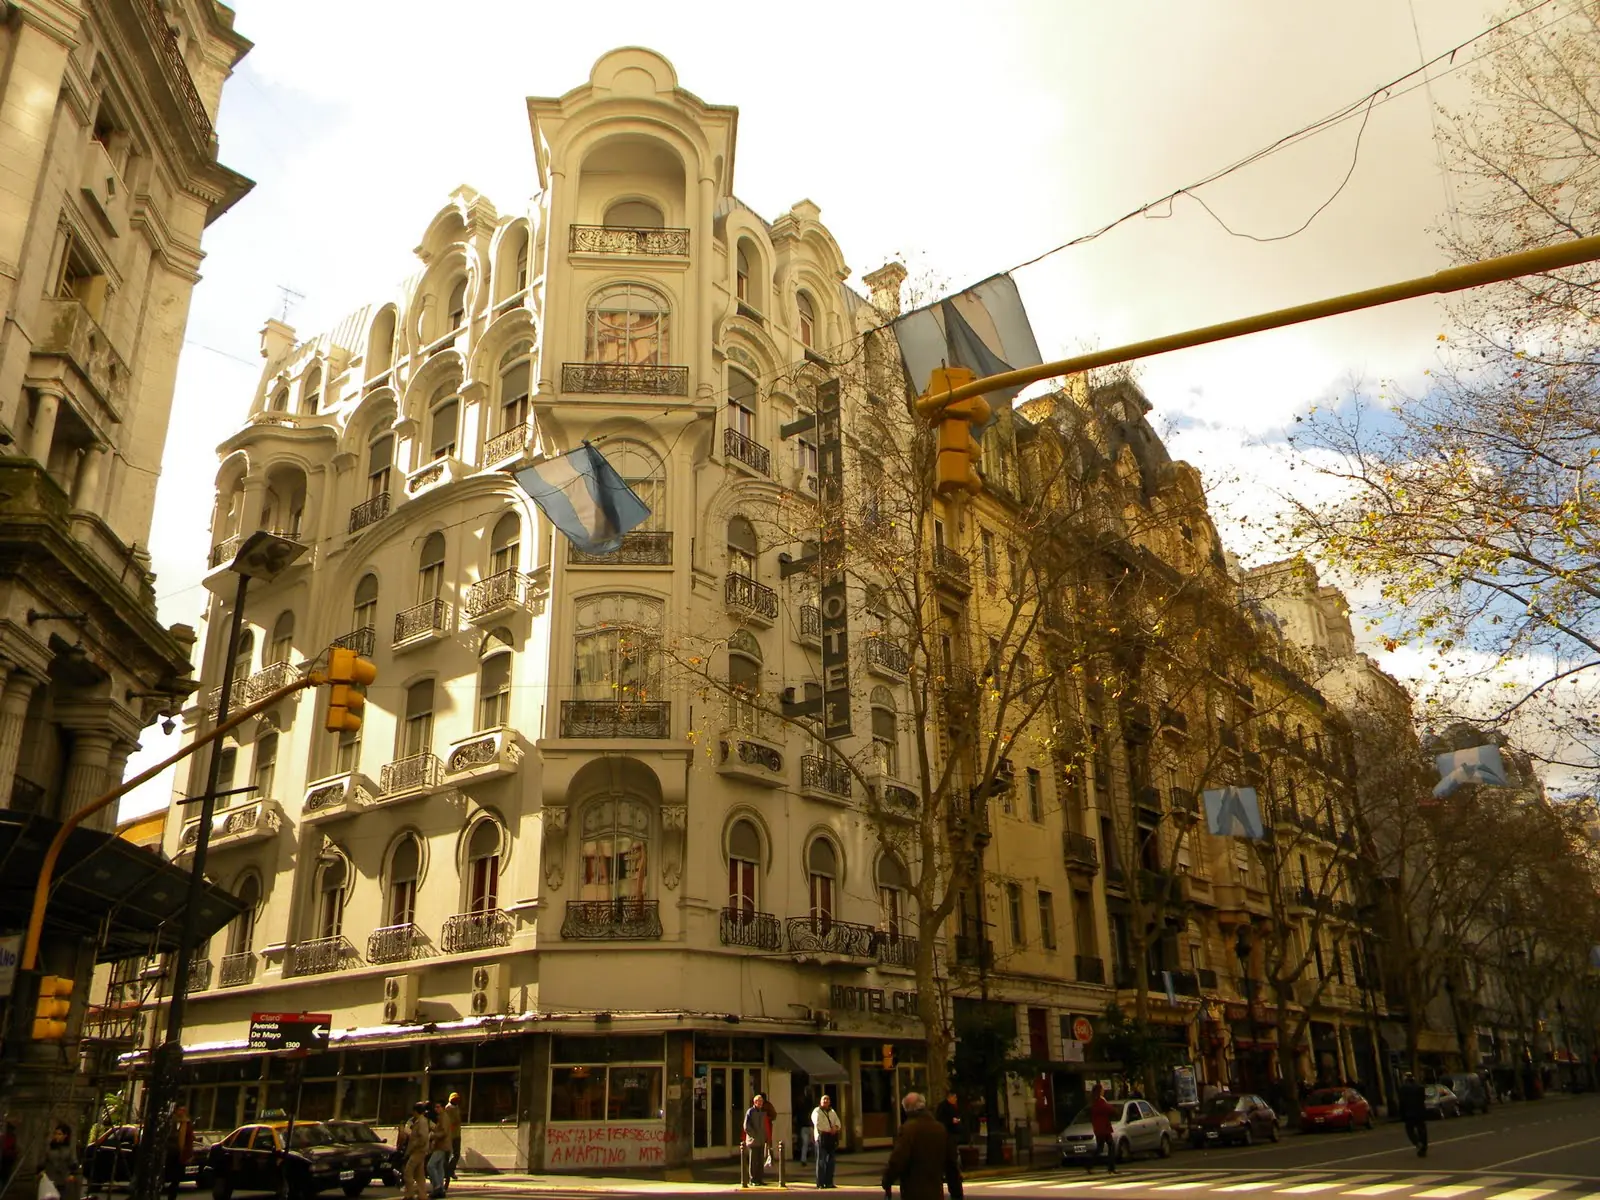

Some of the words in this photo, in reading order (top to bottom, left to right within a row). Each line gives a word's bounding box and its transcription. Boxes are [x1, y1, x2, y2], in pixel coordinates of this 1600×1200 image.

[831, 985, 891, 1014] HOTEL
[547, 1128, 586, 1144] BASTA
[588, 1128, 605, 1142] DE
[551, 1147, 562, 1163] A
[565, 1145, 626, 1164] MARTINO
